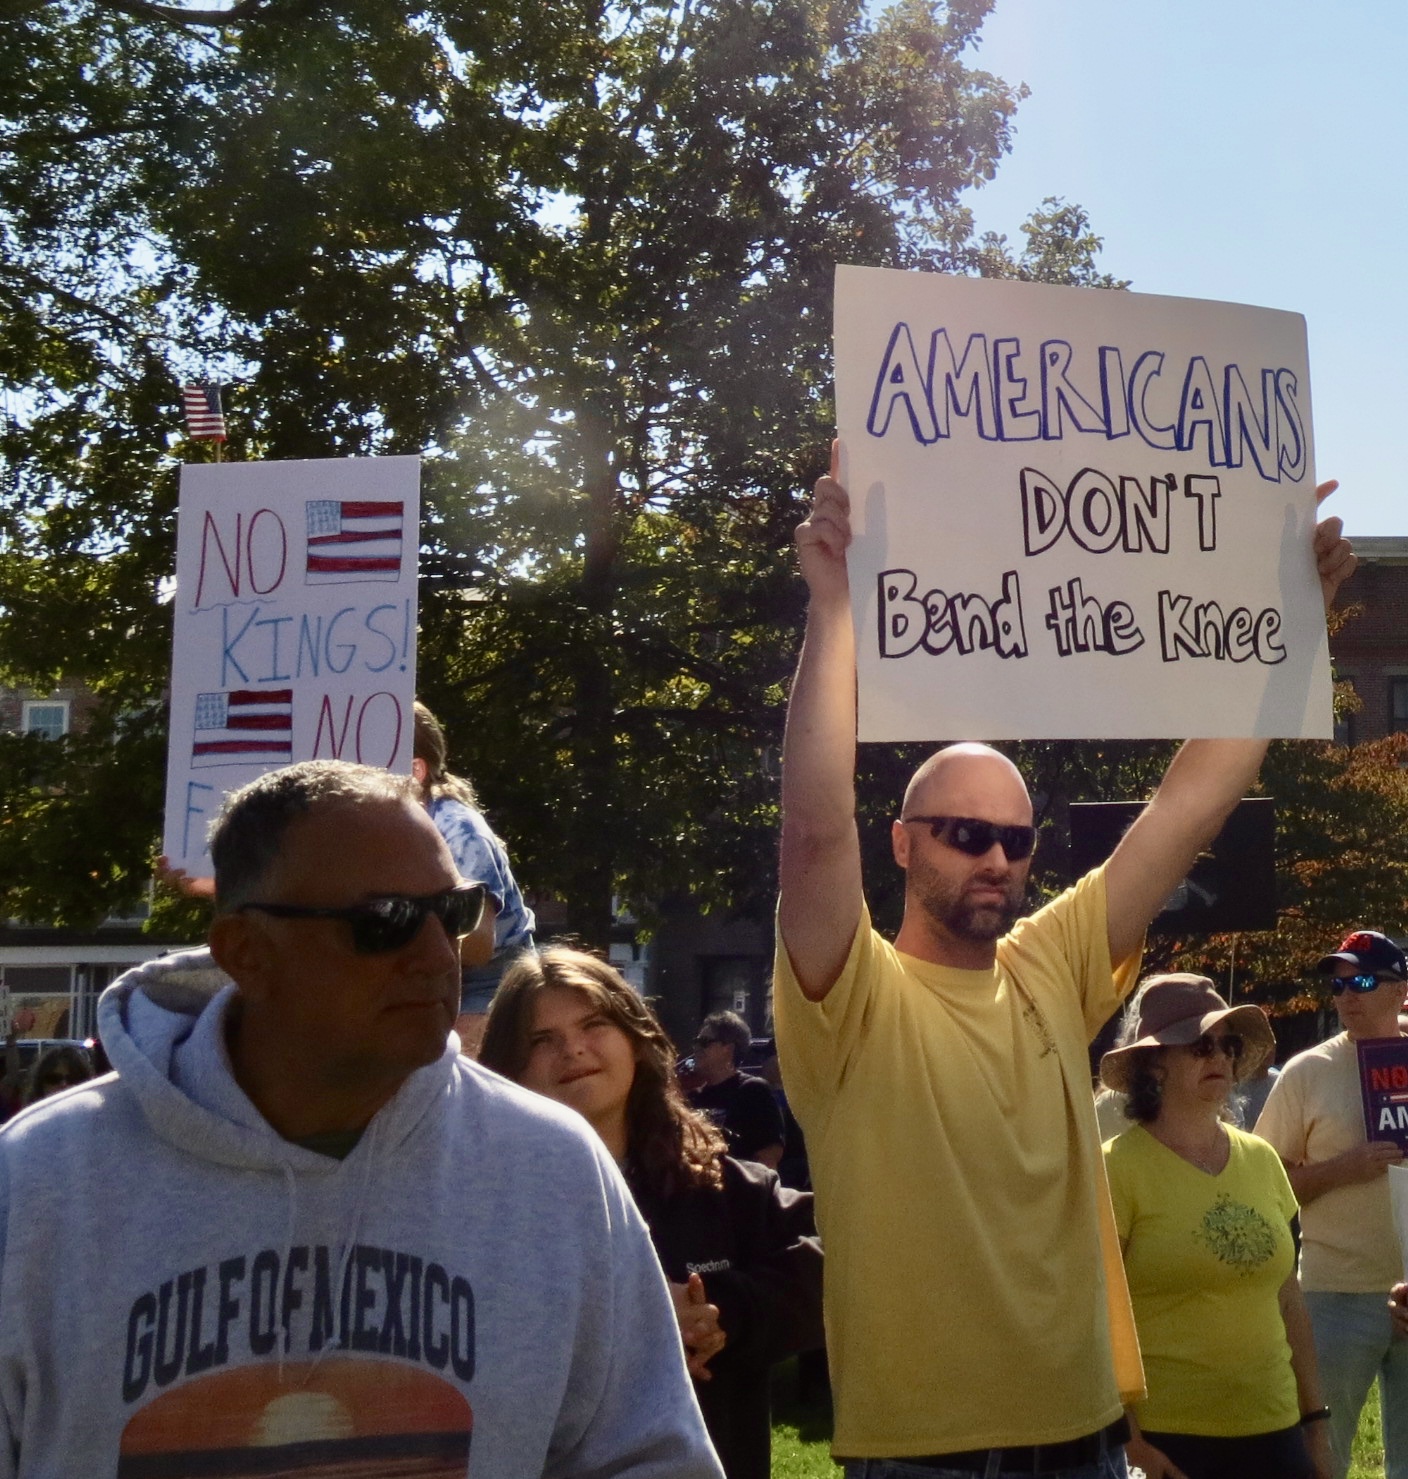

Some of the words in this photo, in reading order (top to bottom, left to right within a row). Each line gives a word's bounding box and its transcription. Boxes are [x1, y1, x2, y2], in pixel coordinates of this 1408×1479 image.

[867, 322, 1307, 483] AMERICANS
[1020, 467, 1222, 556] DON'T
[195, 508, 287, 608] NO
[220, 599, 410, 687] KINGS!
[877, 569, 1028, 659] Bend
[1046, 577, 1144, 657] the
[1158, 590, 1287, 665] Knee
[312, 691, 401, 768] NO
[1371, 1066, 1408, 1090] NO
[122, 1254, 247, 1405] GULF
[250, 1245, 310, 1356] OF
[309, 1243, 476, 1383] MEXICO
